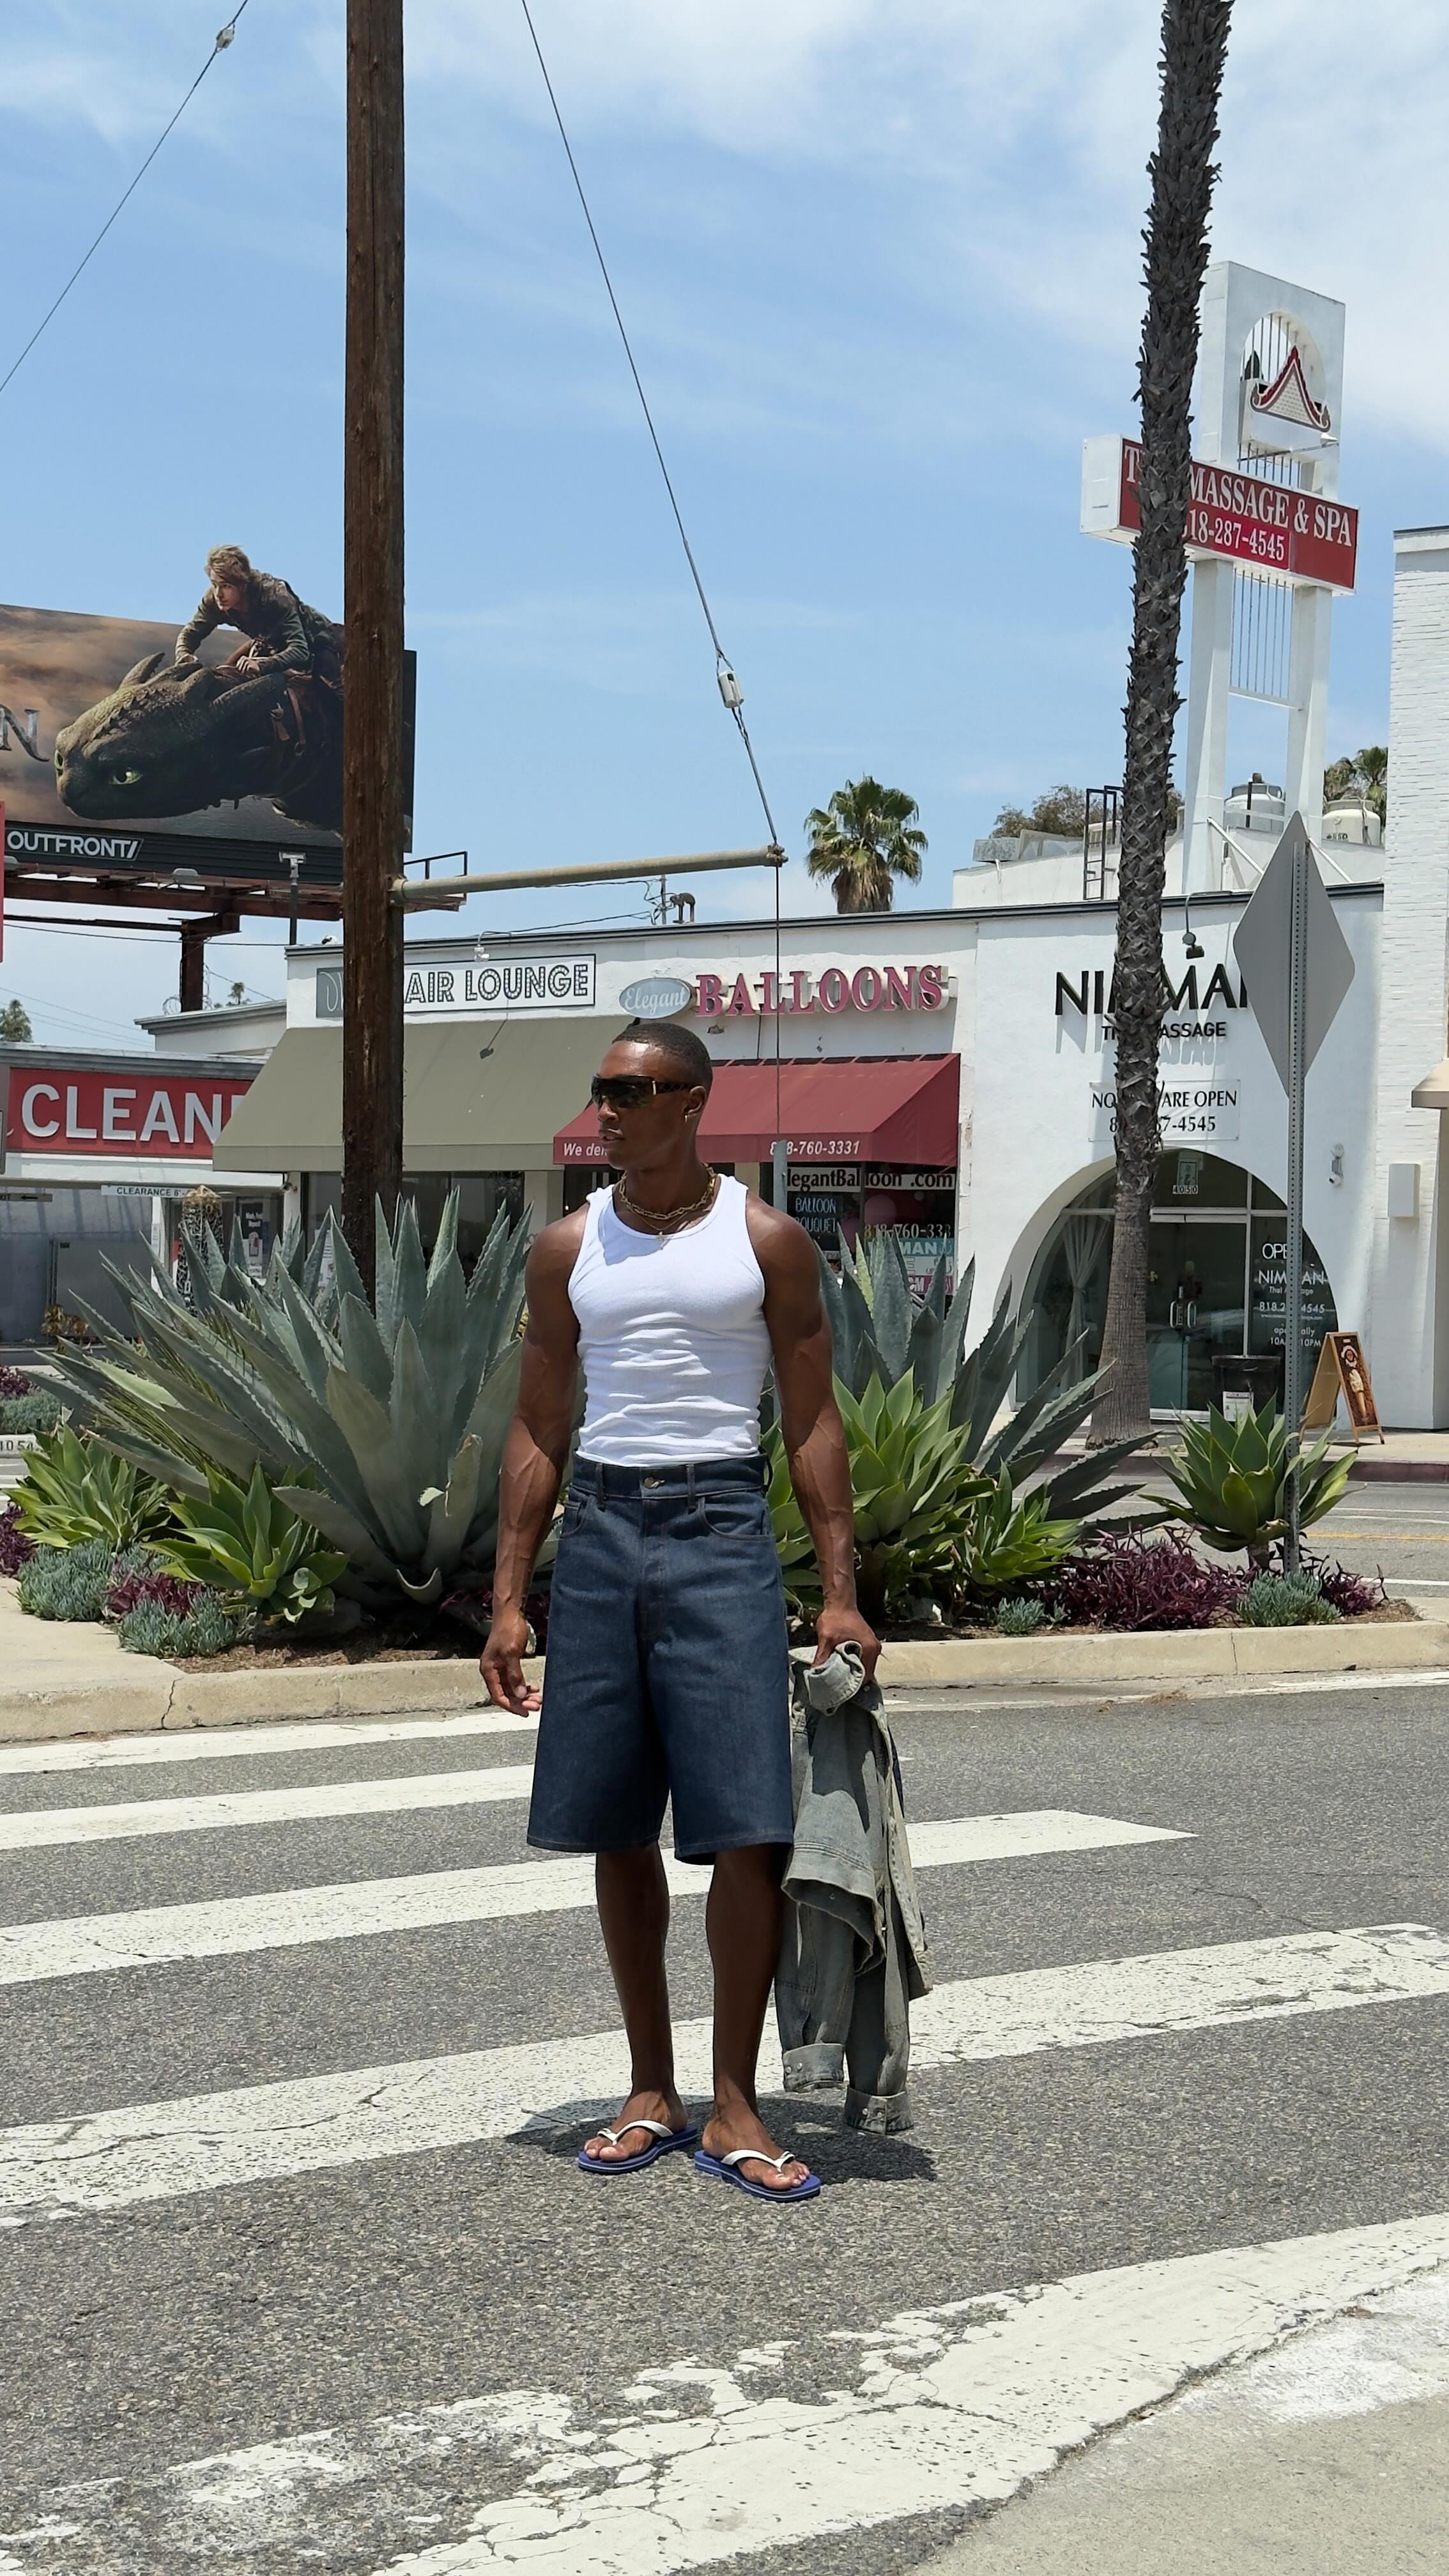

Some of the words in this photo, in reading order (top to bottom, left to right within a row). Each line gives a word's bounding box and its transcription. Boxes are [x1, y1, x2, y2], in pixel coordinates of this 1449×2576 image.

[1189, 465, 1289, 528] MASSAGE
[1294, 499, 1308, 534] &
[1314, 504, 1352, 547] SPA
[1183, 509, 1285, 561] 18-287-4545
[465, 963, 588, 1001] LOUNGE
[1055, 963, 1248, 1015] NIMA
[625, 987, 686, 1016] Elegant
[695, 965, 946, 1017] BALLOONS
[1160, 1022, 1227, 1038] ASSAGE
[1092, 1092, 1116, 1108] NO
[1162, 1091, 1190, 1107] ARE
[1194, 1090, 1238, 1107] OPEN
[564, 1143, 582, 1156] We
[770, 1140, 860, 1156] 88-760-3331
[117, 1187, 171, 1196] CLEARANCE
[1172, 1185, 1197, 1193] 4050
[795, 1197, 836, 1213] BALLOON
[1262, 1243, 1287, 1259] OPE
[1259, 1269, 1324, 1285] NIMAN
